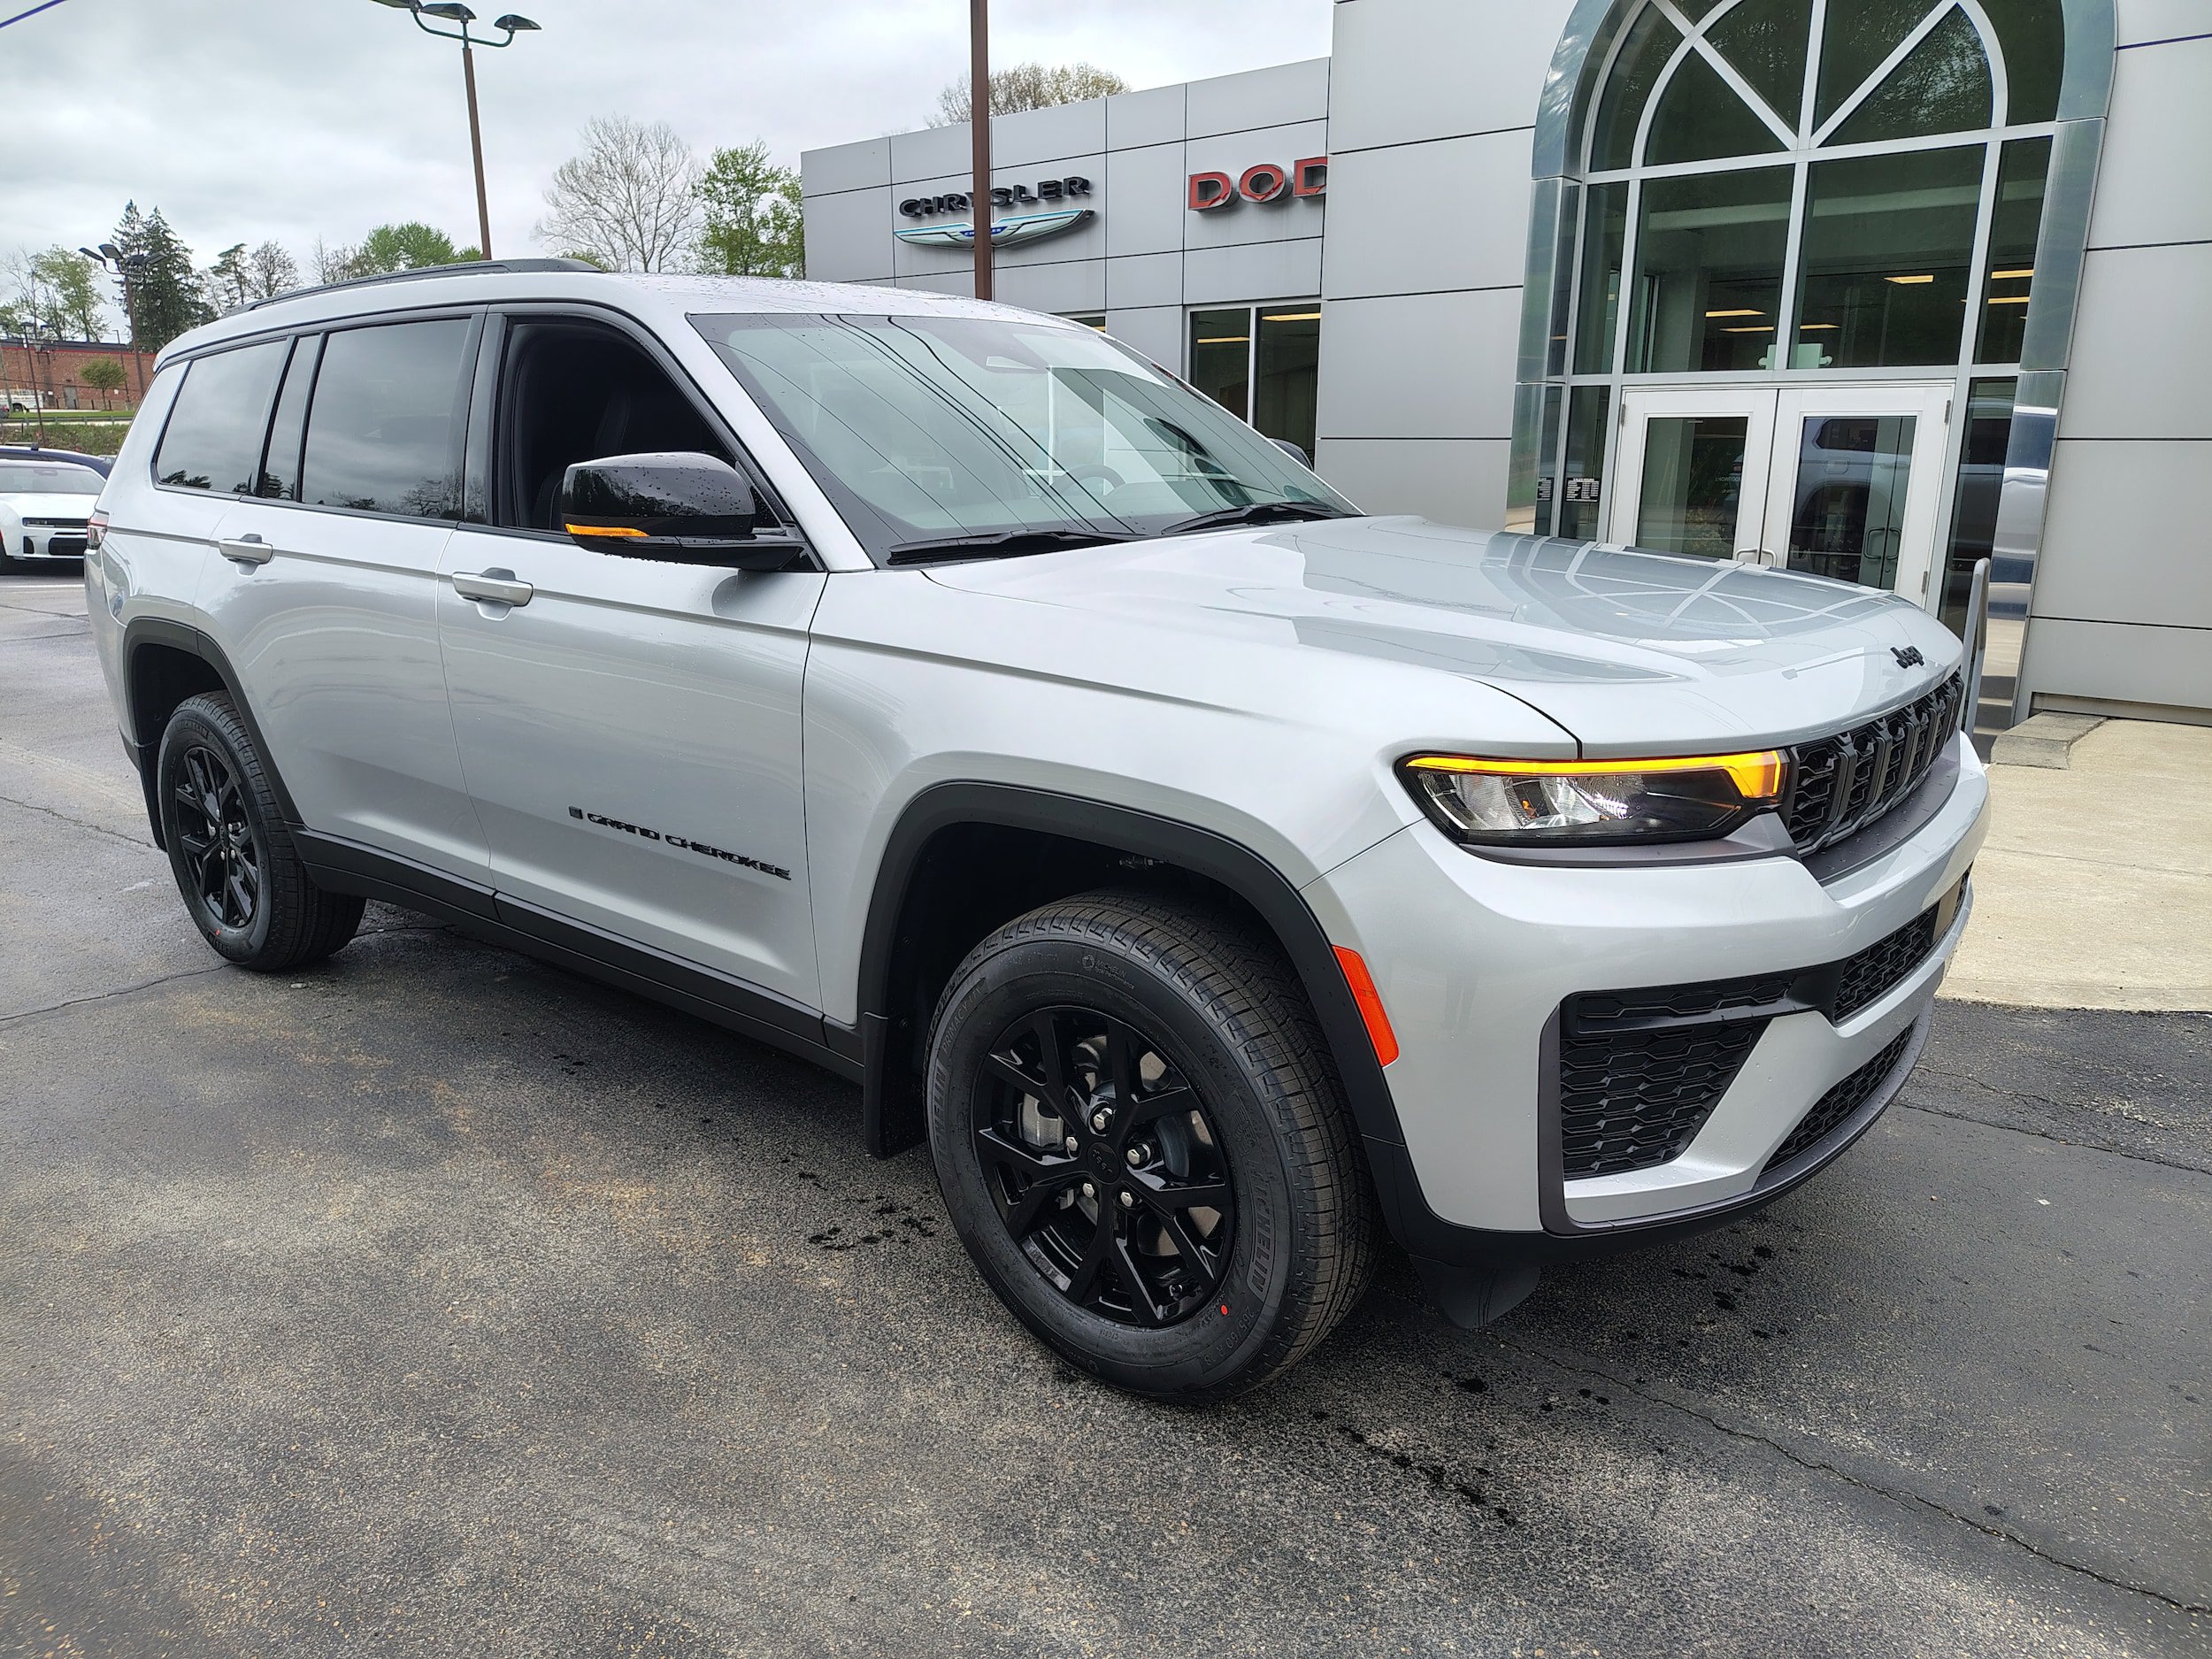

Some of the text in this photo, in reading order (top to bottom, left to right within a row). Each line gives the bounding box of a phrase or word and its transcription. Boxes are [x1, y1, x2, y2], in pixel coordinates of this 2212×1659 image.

[1890, 645, 1924, 669] Jeep
[587, 812, 792, 881] GRAND CHEROKEE
[941, 1004, 968, 1054] PRIMACY
[933, 1067, 952, 1178] MICHELIN
[1247, 1159, 1271, 1294] MICHELIN
